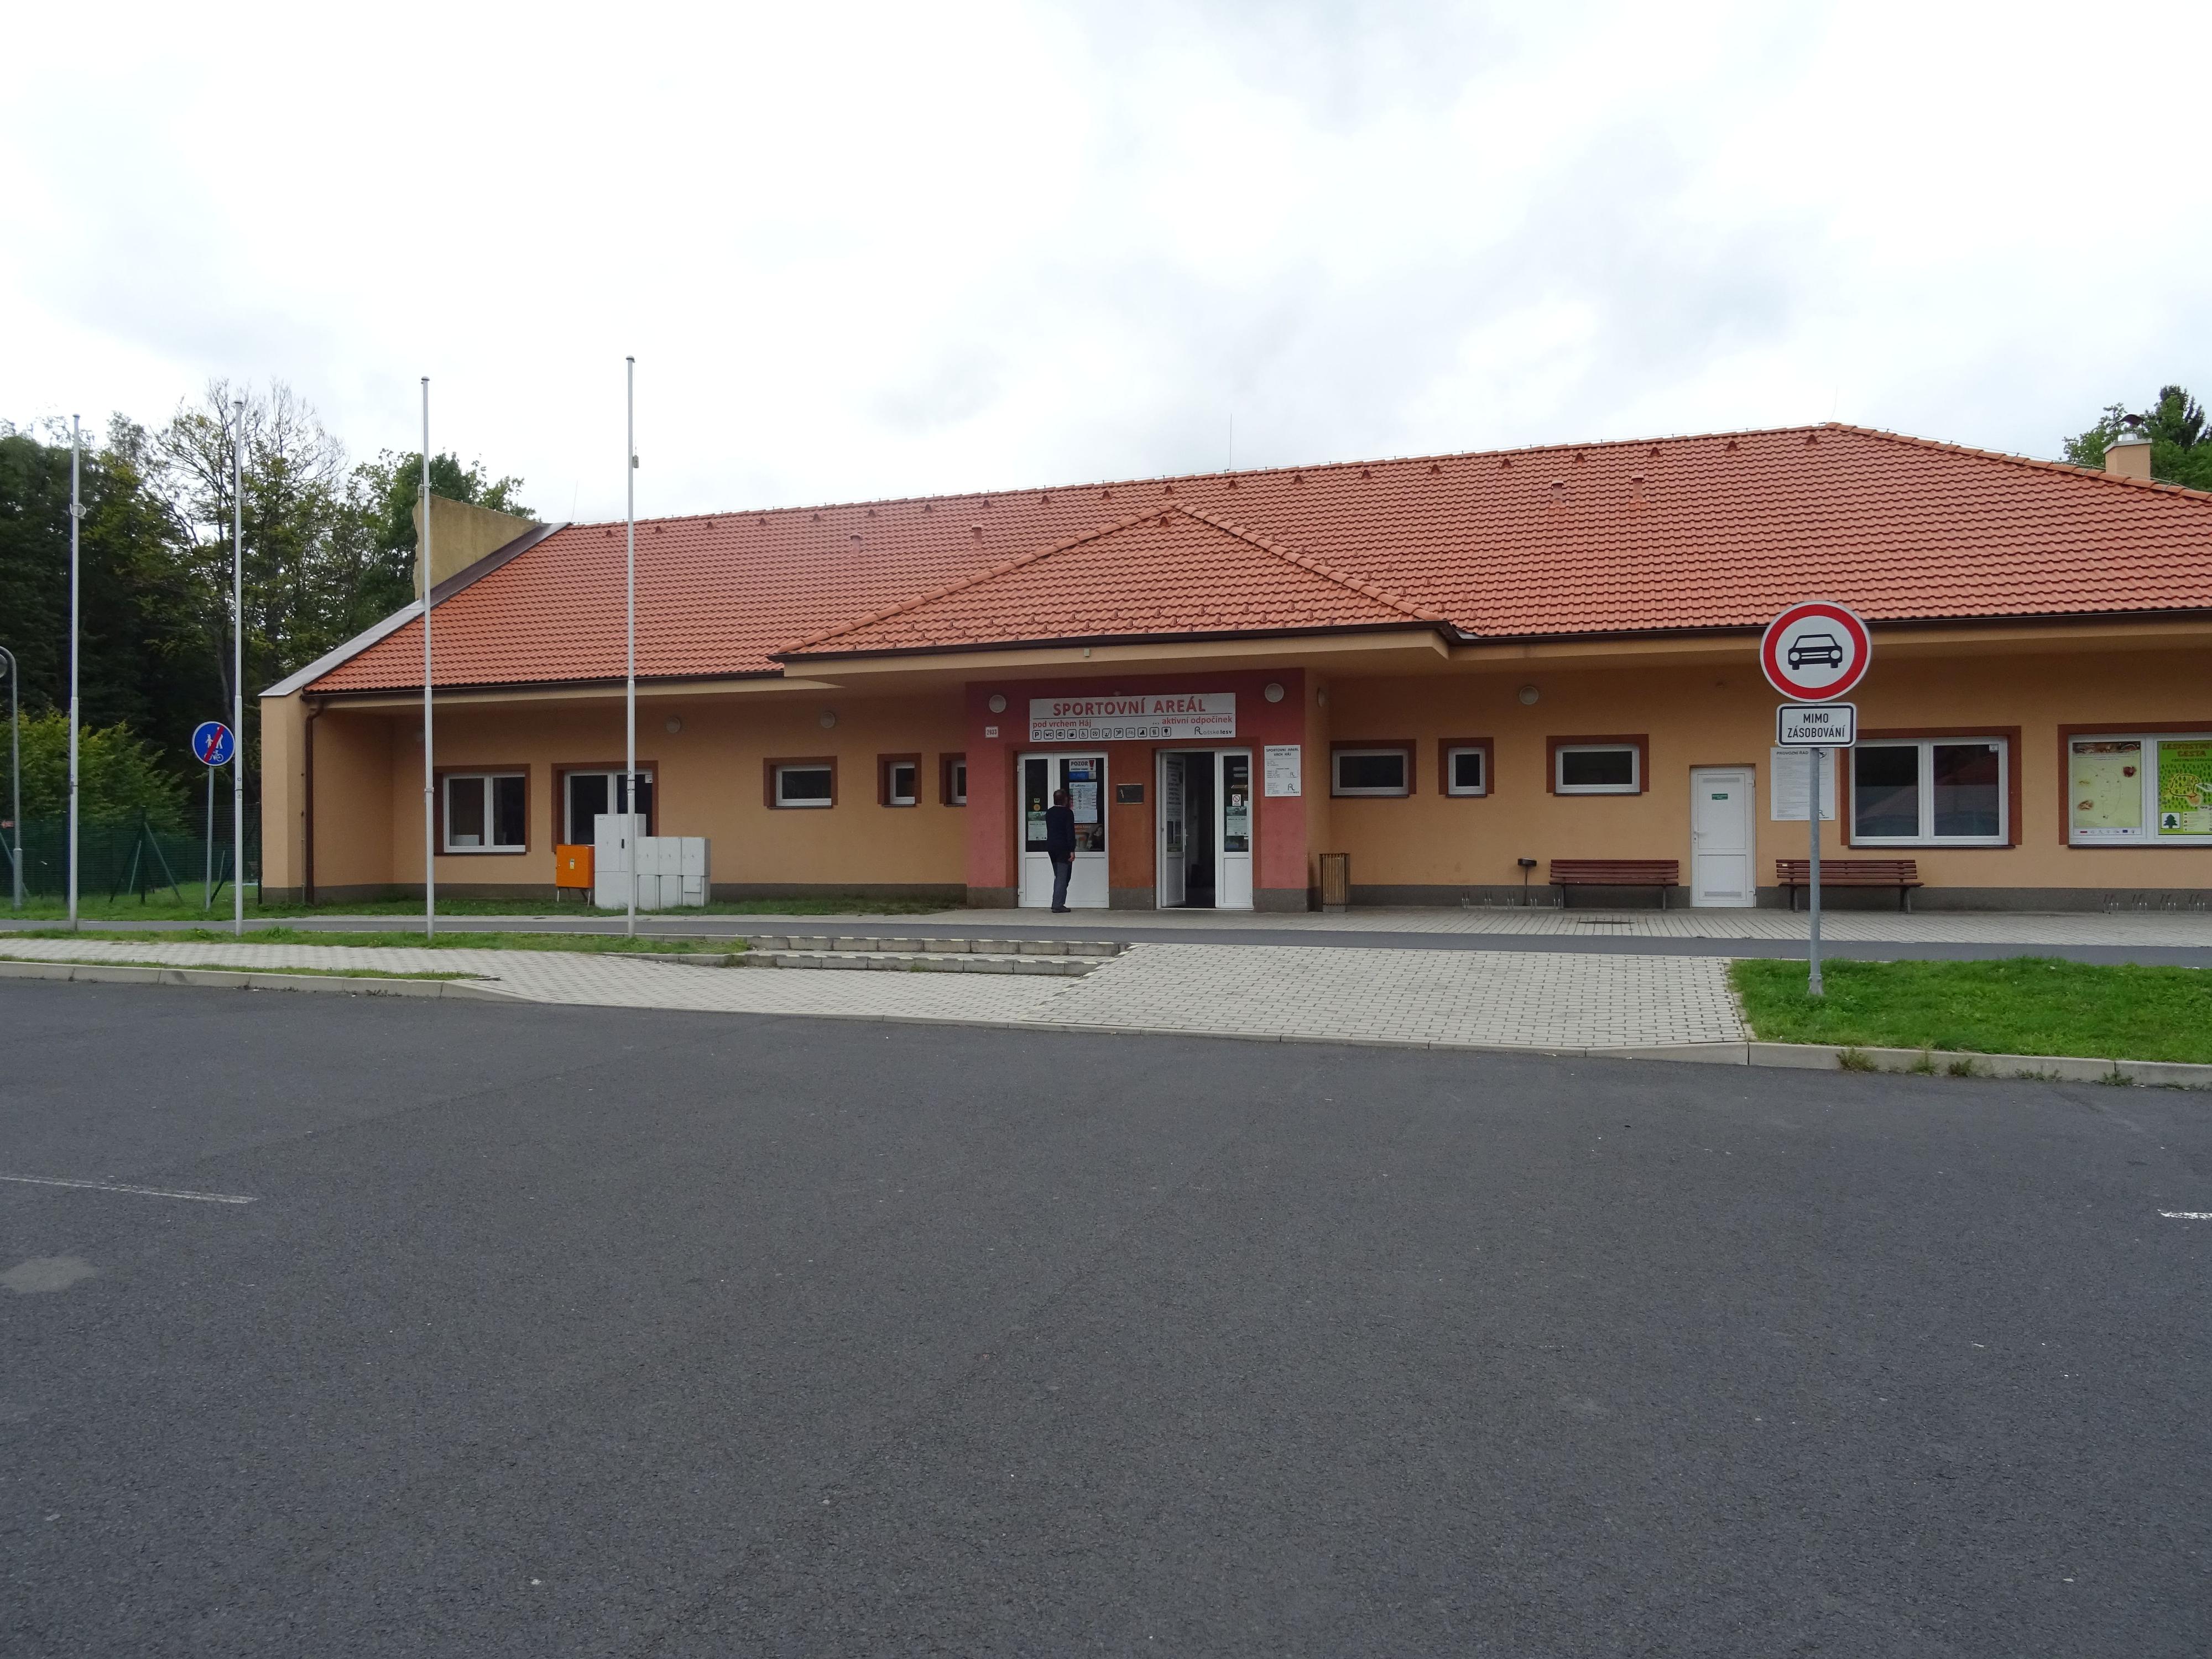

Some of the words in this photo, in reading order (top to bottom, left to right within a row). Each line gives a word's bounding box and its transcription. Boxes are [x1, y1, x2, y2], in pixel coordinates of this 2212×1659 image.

[1053, 697, 1146, 716] SPORTOVNÍ
[1154, 696, 1206, 713] AREÁL
[1191, 716, 1233, 725] odpočinek
[1803, 713, 1829, 723] MIMO
[1079, 719, 1092, 728] Háj
[1787, 724, 1846, 738] ZÁSOBOVÁNÍ
